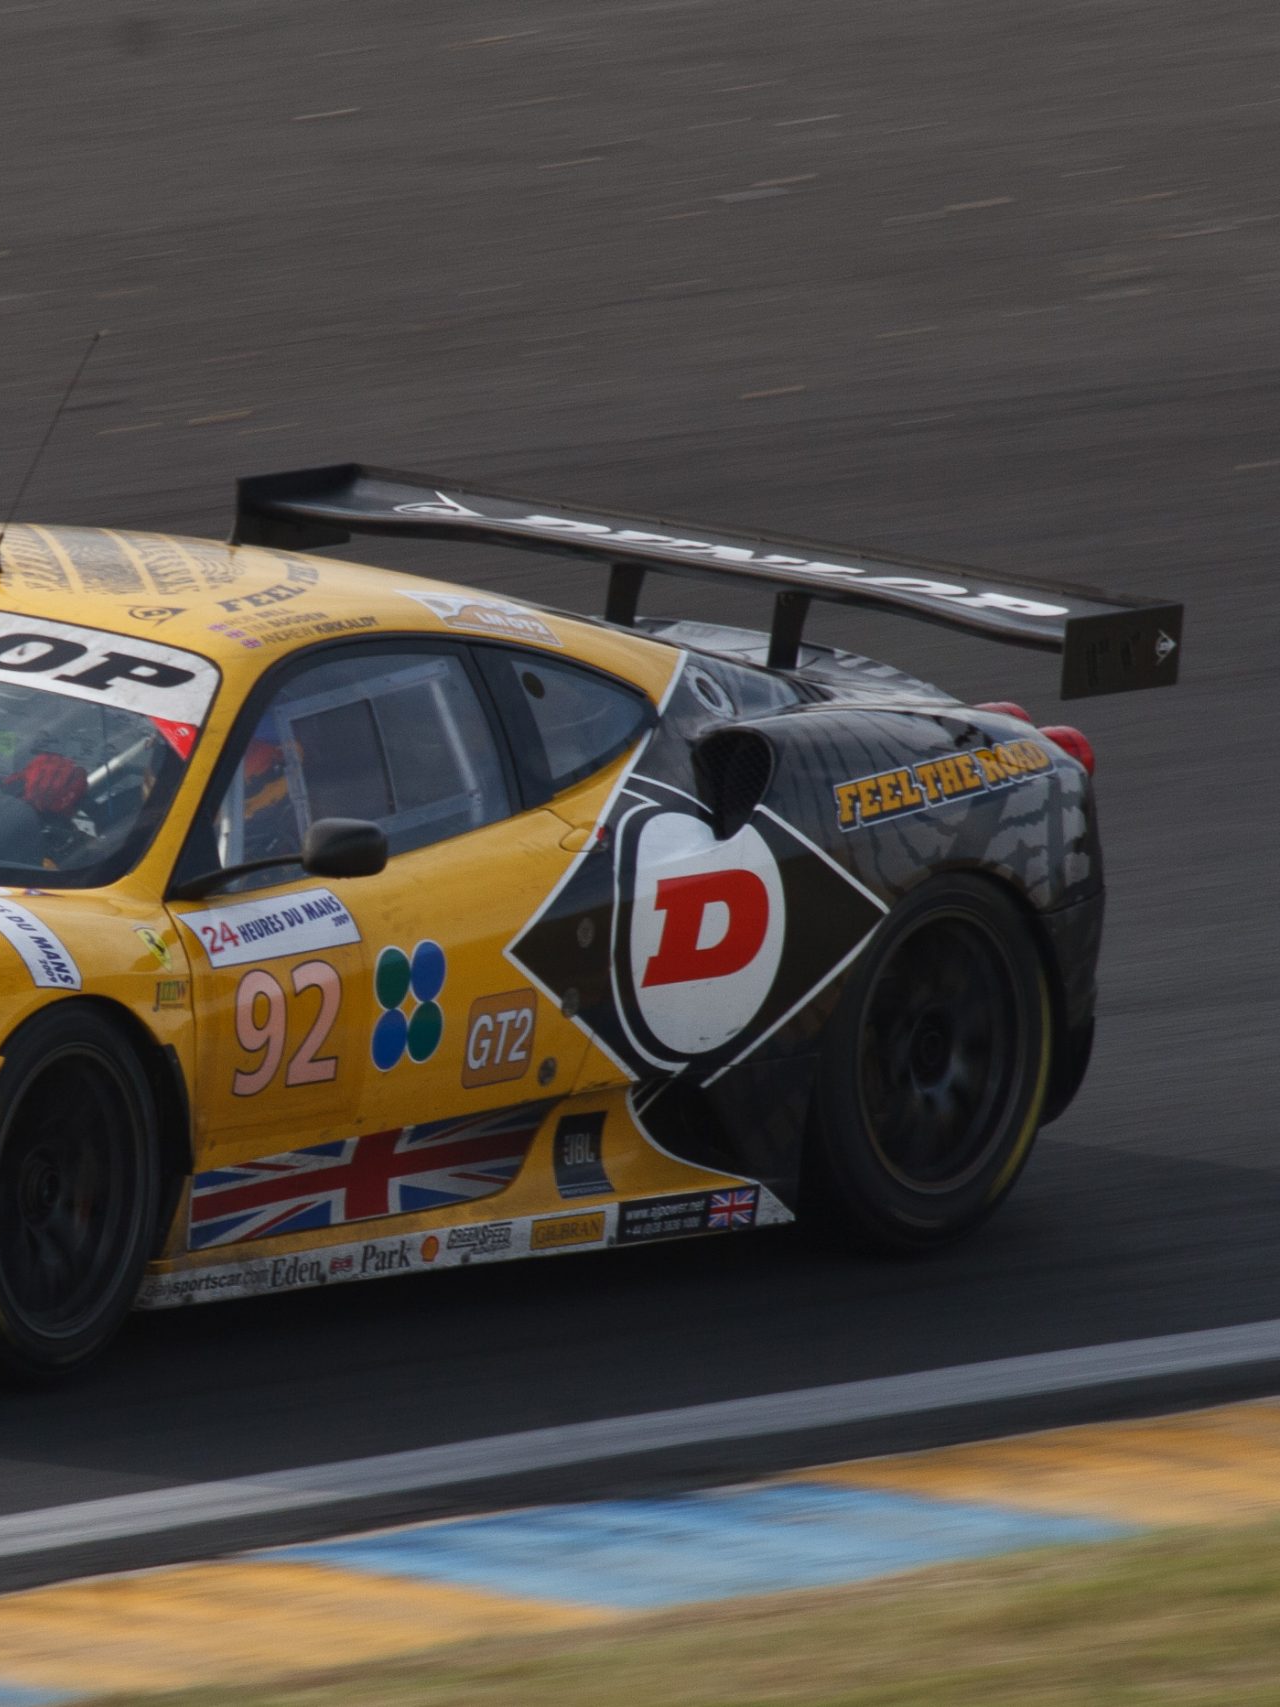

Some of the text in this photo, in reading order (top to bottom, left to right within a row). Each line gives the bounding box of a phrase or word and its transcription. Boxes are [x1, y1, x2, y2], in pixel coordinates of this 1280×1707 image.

[217, 584, 306, 613] FEEL
[501, 514, 1068, 617] DUNLOP
[835, 740, 1053, 826] FEEL THE ROAD
[5, 915, 38, 931] DU
[28, 935, 75, 984] MANS
[201, 896, 342, 954] 24 HEURES DU MANS
[641, 868, 769, 988] D
[231, 959, 342, 1098] 92
[467, 1007, 534, 1071] GT2
[563, 1132, 596, 1166] JBL
[270, 1239, 411, 1288] Eden Park
